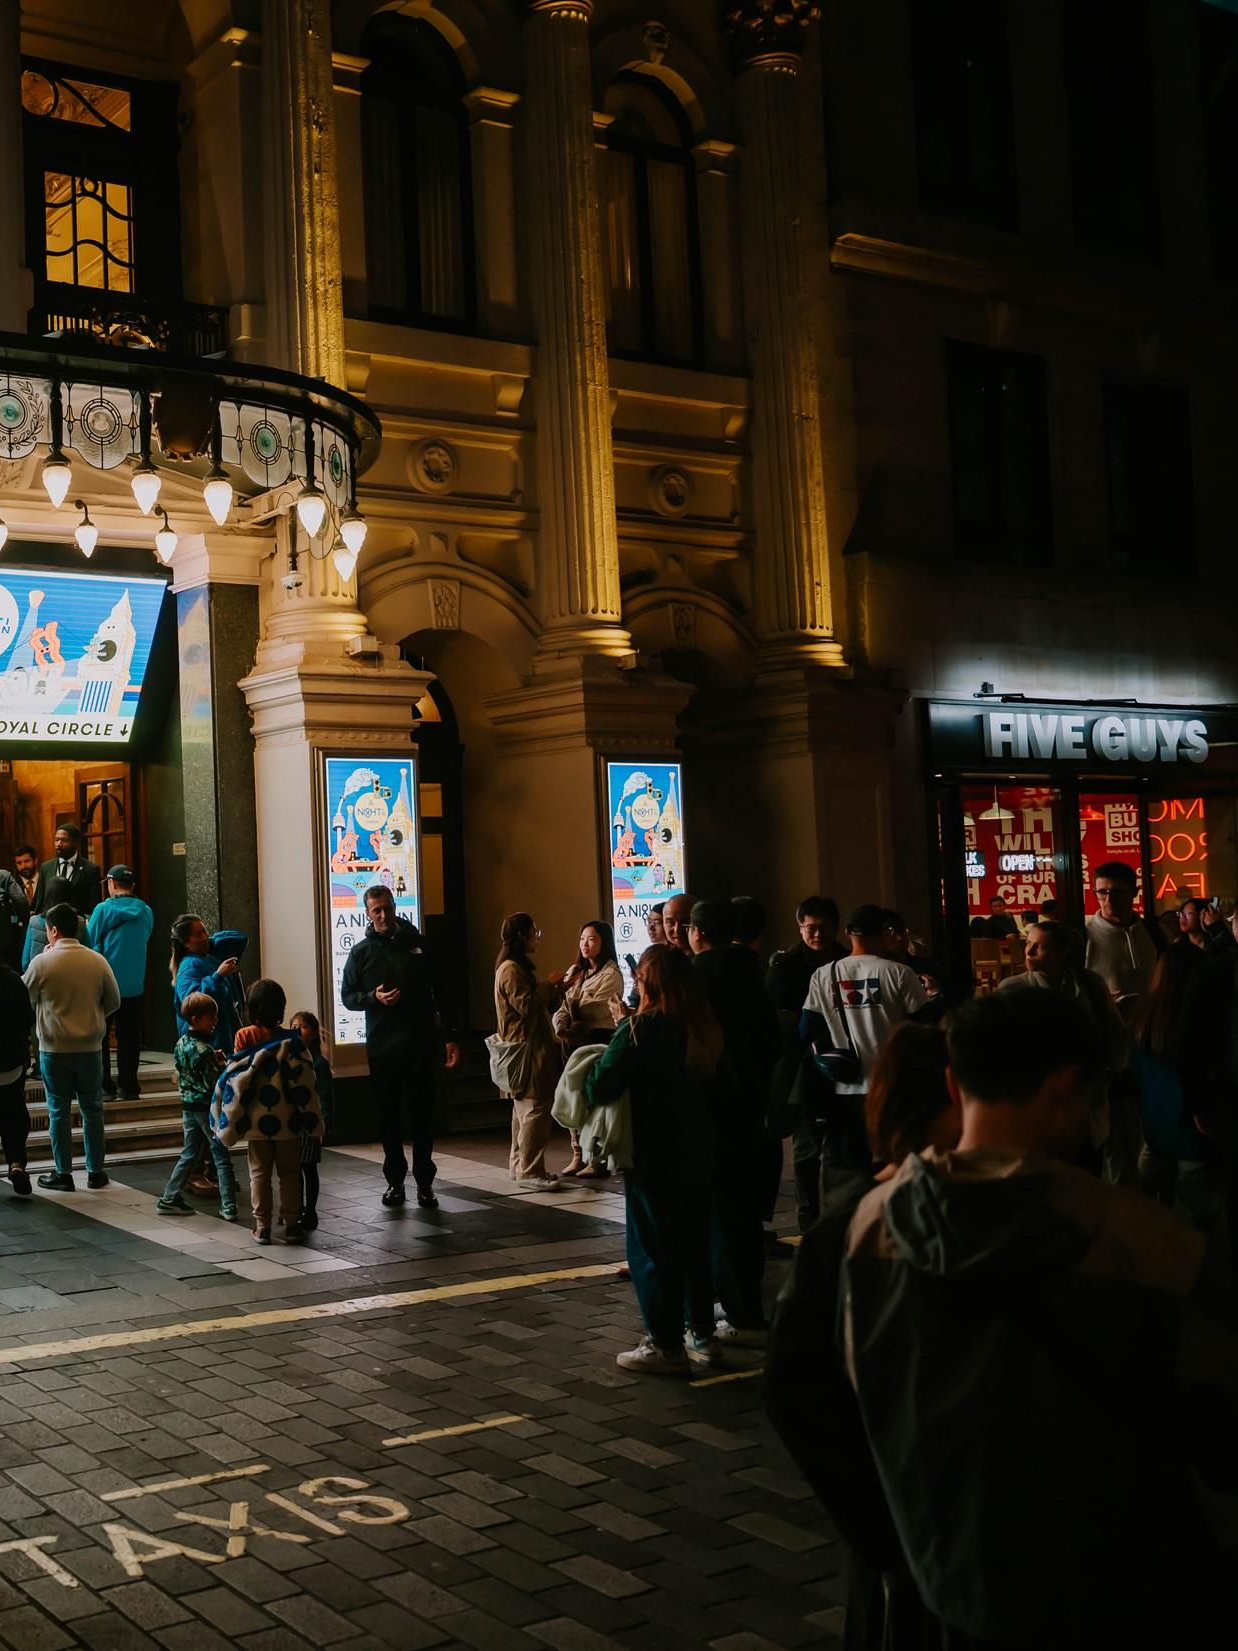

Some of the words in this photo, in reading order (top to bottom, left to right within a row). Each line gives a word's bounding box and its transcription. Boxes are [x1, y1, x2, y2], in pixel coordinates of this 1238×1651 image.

[47, 722, 114, 737] CIRCLE
[982, 712, 1088, 760] FIVE
[1092, 716, 1209, 763] GUYS
[1001, 854, 1036, 871] OPEN
